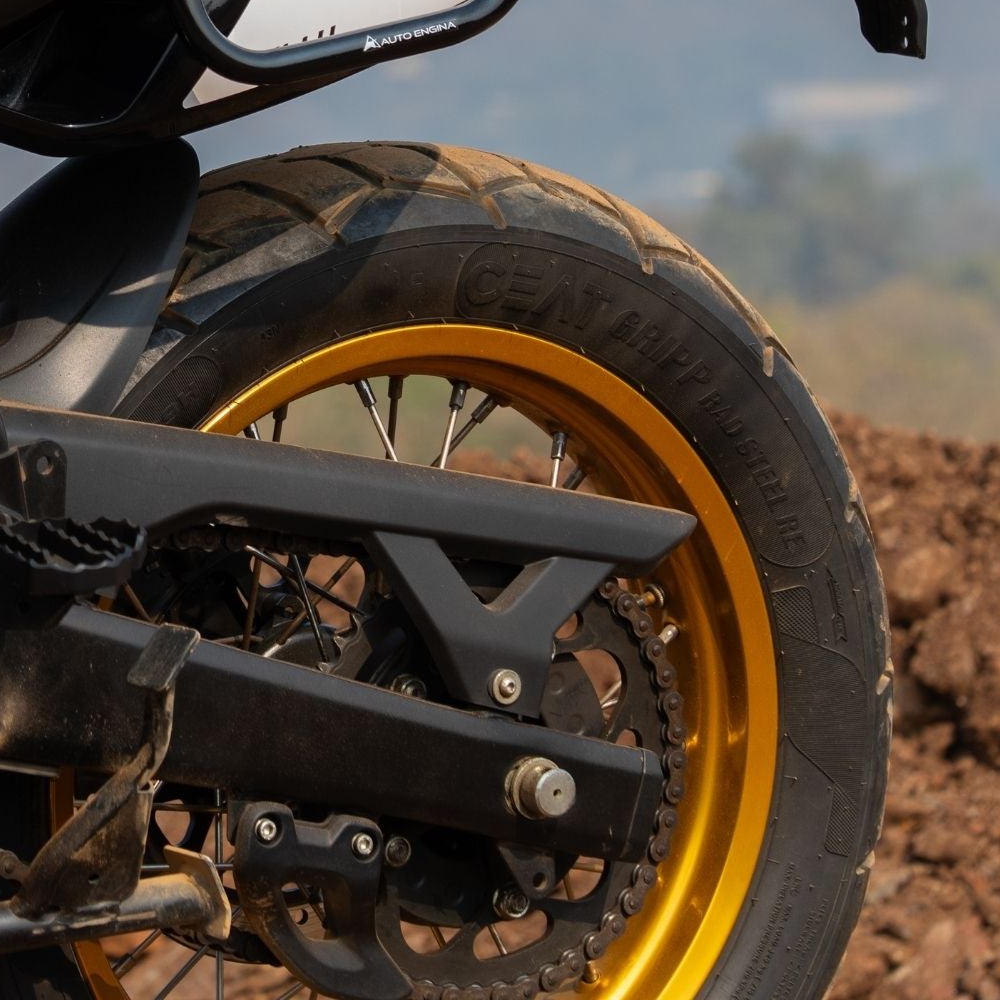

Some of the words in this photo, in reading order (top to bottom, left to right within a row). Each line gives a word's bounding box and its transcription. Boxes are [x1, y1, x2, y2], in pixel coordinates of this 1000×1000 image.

[381, 32, 412, 47] AUTO
[413, 20, 457, 38] ENGINA
[465, 261, 616, 331] CEAT
[609, 310, 713, 385] GRIPP
